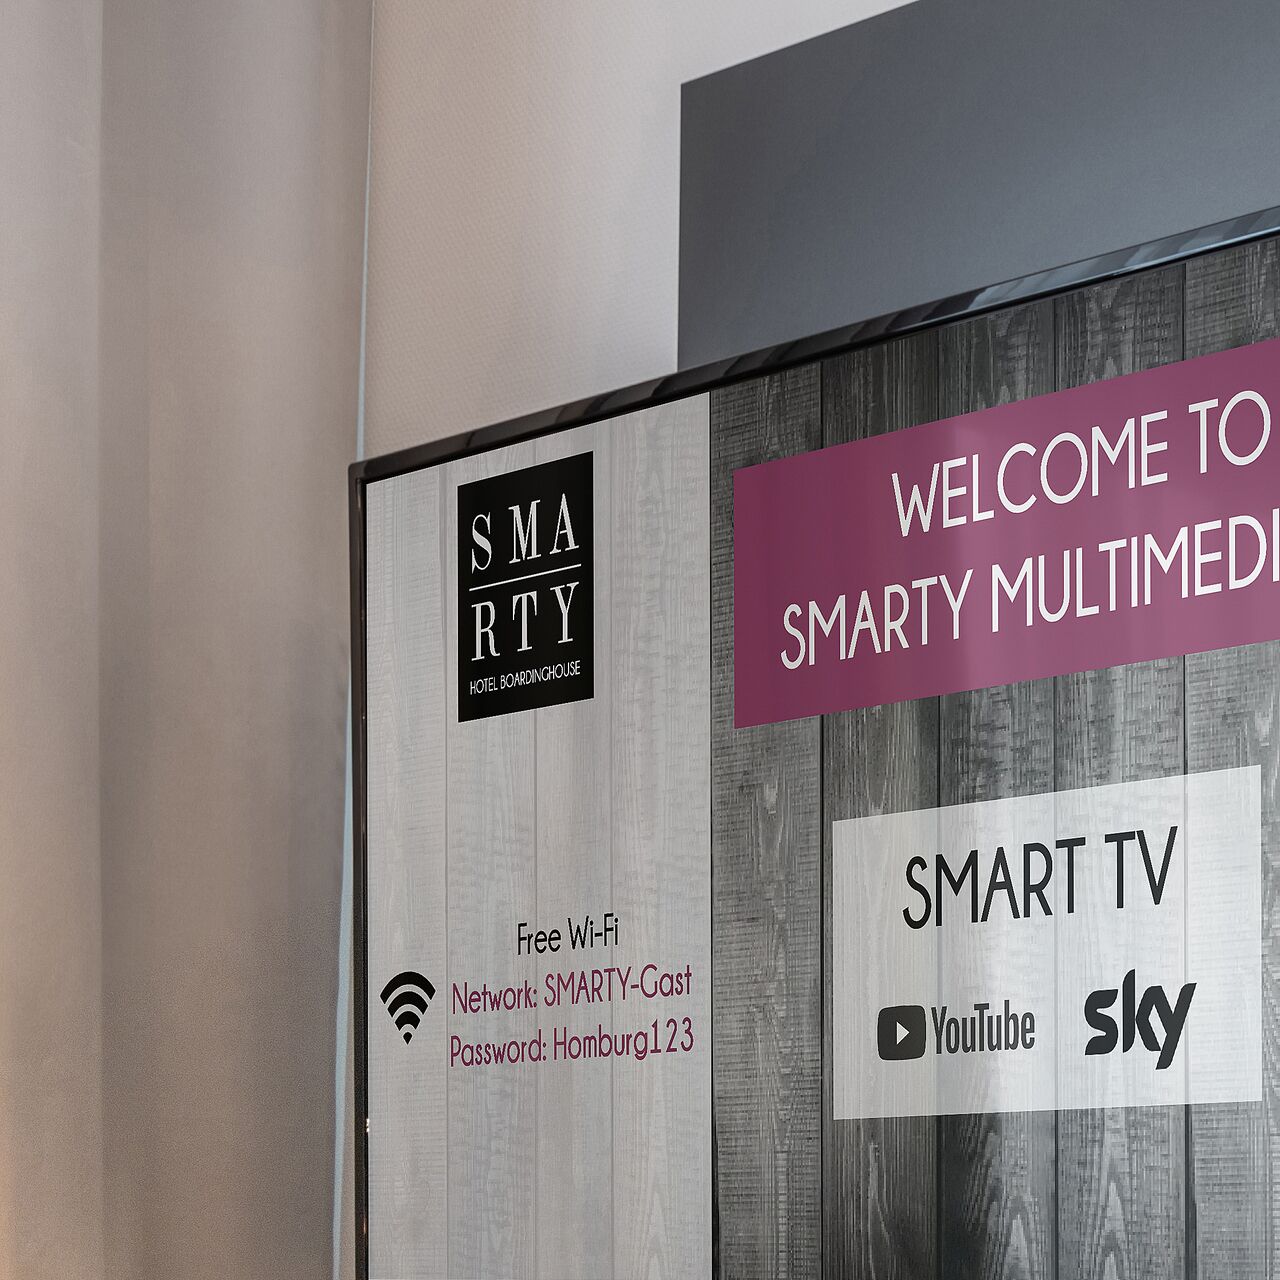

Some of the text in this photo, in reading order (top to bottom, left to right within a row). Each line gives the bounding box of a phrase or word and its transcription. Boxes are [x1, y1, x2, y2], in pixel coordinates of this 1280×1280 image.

[891, 390, 1272, 538] WELCOME TO
[471, 493, 580, 575] SMA
[471, 581, 580, 662] RTY
[780, 568, 974, 670] SMARTY
[470, 660, 581, 695] HOTEL BOARDINGHOUSE
[902, 826, 1178, 930] SMART TV
[517, 912, 619, 955] Free Wi-Fi
[452, 964, 692, 1014] Network: SMARTY-Gast
[931, 1000, 1036, 1056] YouTube
[1084, 969, 1197, 1070] sky
[450, 1017, 694, 1067] Password: Homburg123
